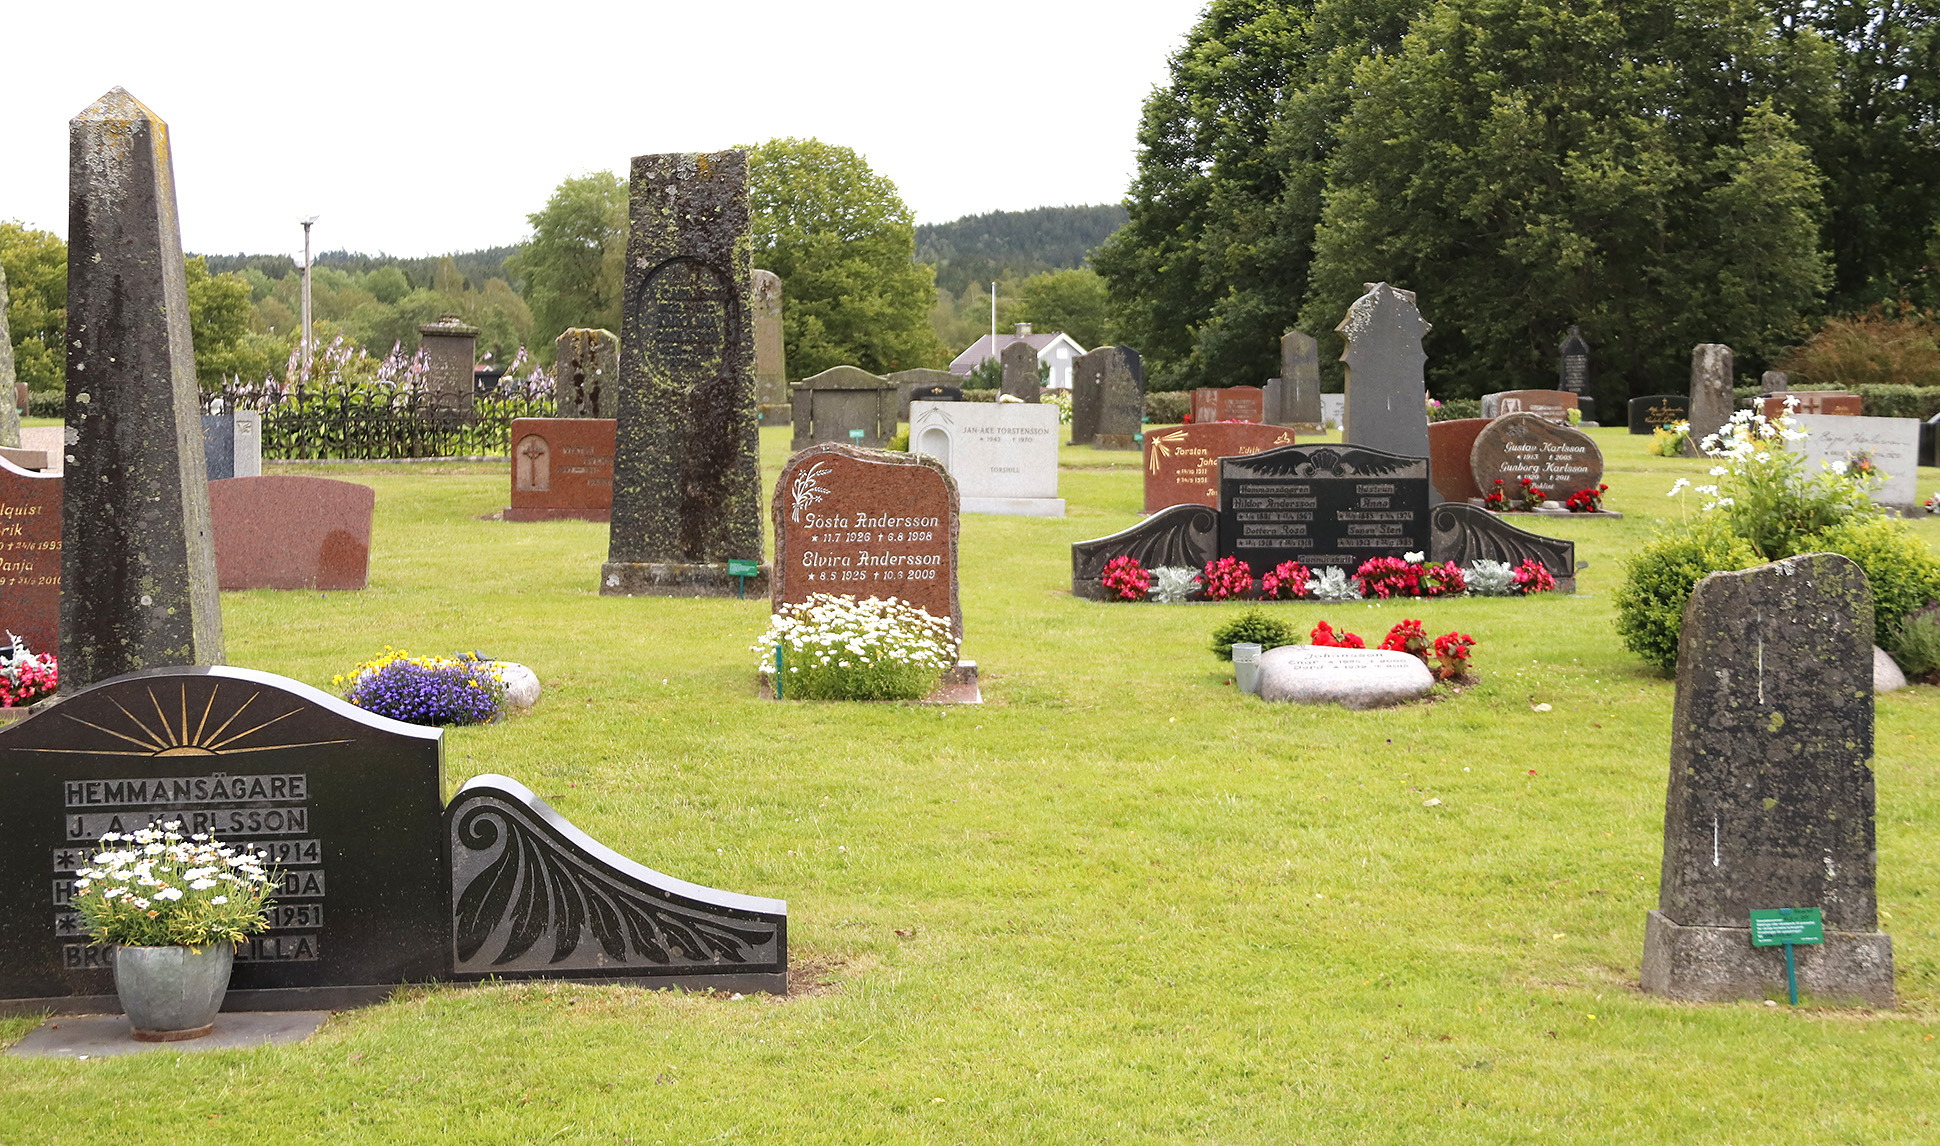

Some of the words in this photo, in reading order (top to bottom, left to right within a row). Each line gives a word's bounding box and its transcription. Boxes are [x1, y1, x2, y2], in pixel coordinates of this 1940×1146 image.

[1540, 442, 1586, 453] Karlsson
[1500, 462, 1540, 473] Gunborg
[1542, 462, 1589, 473] Karlsson
[804, 512, 849, 529] Gösta
[854, 512, 939, 528] Andersson
[0, 522, 23, 536] rik
[845, 532, 871, 543] 1926
[887, 533, 904, 543] 6.8
[907, 531, 933, 542] 1998
[802, 551, 851, 567] Elvira
[856, 550, 941, 566] Andersson
[842, 570, 867, 581] 1925
[907, 569, 936, 580] 2009
[67, 773, 304, 804] HEMMANSÄGARE
[70, 816, 92, 838] J.
